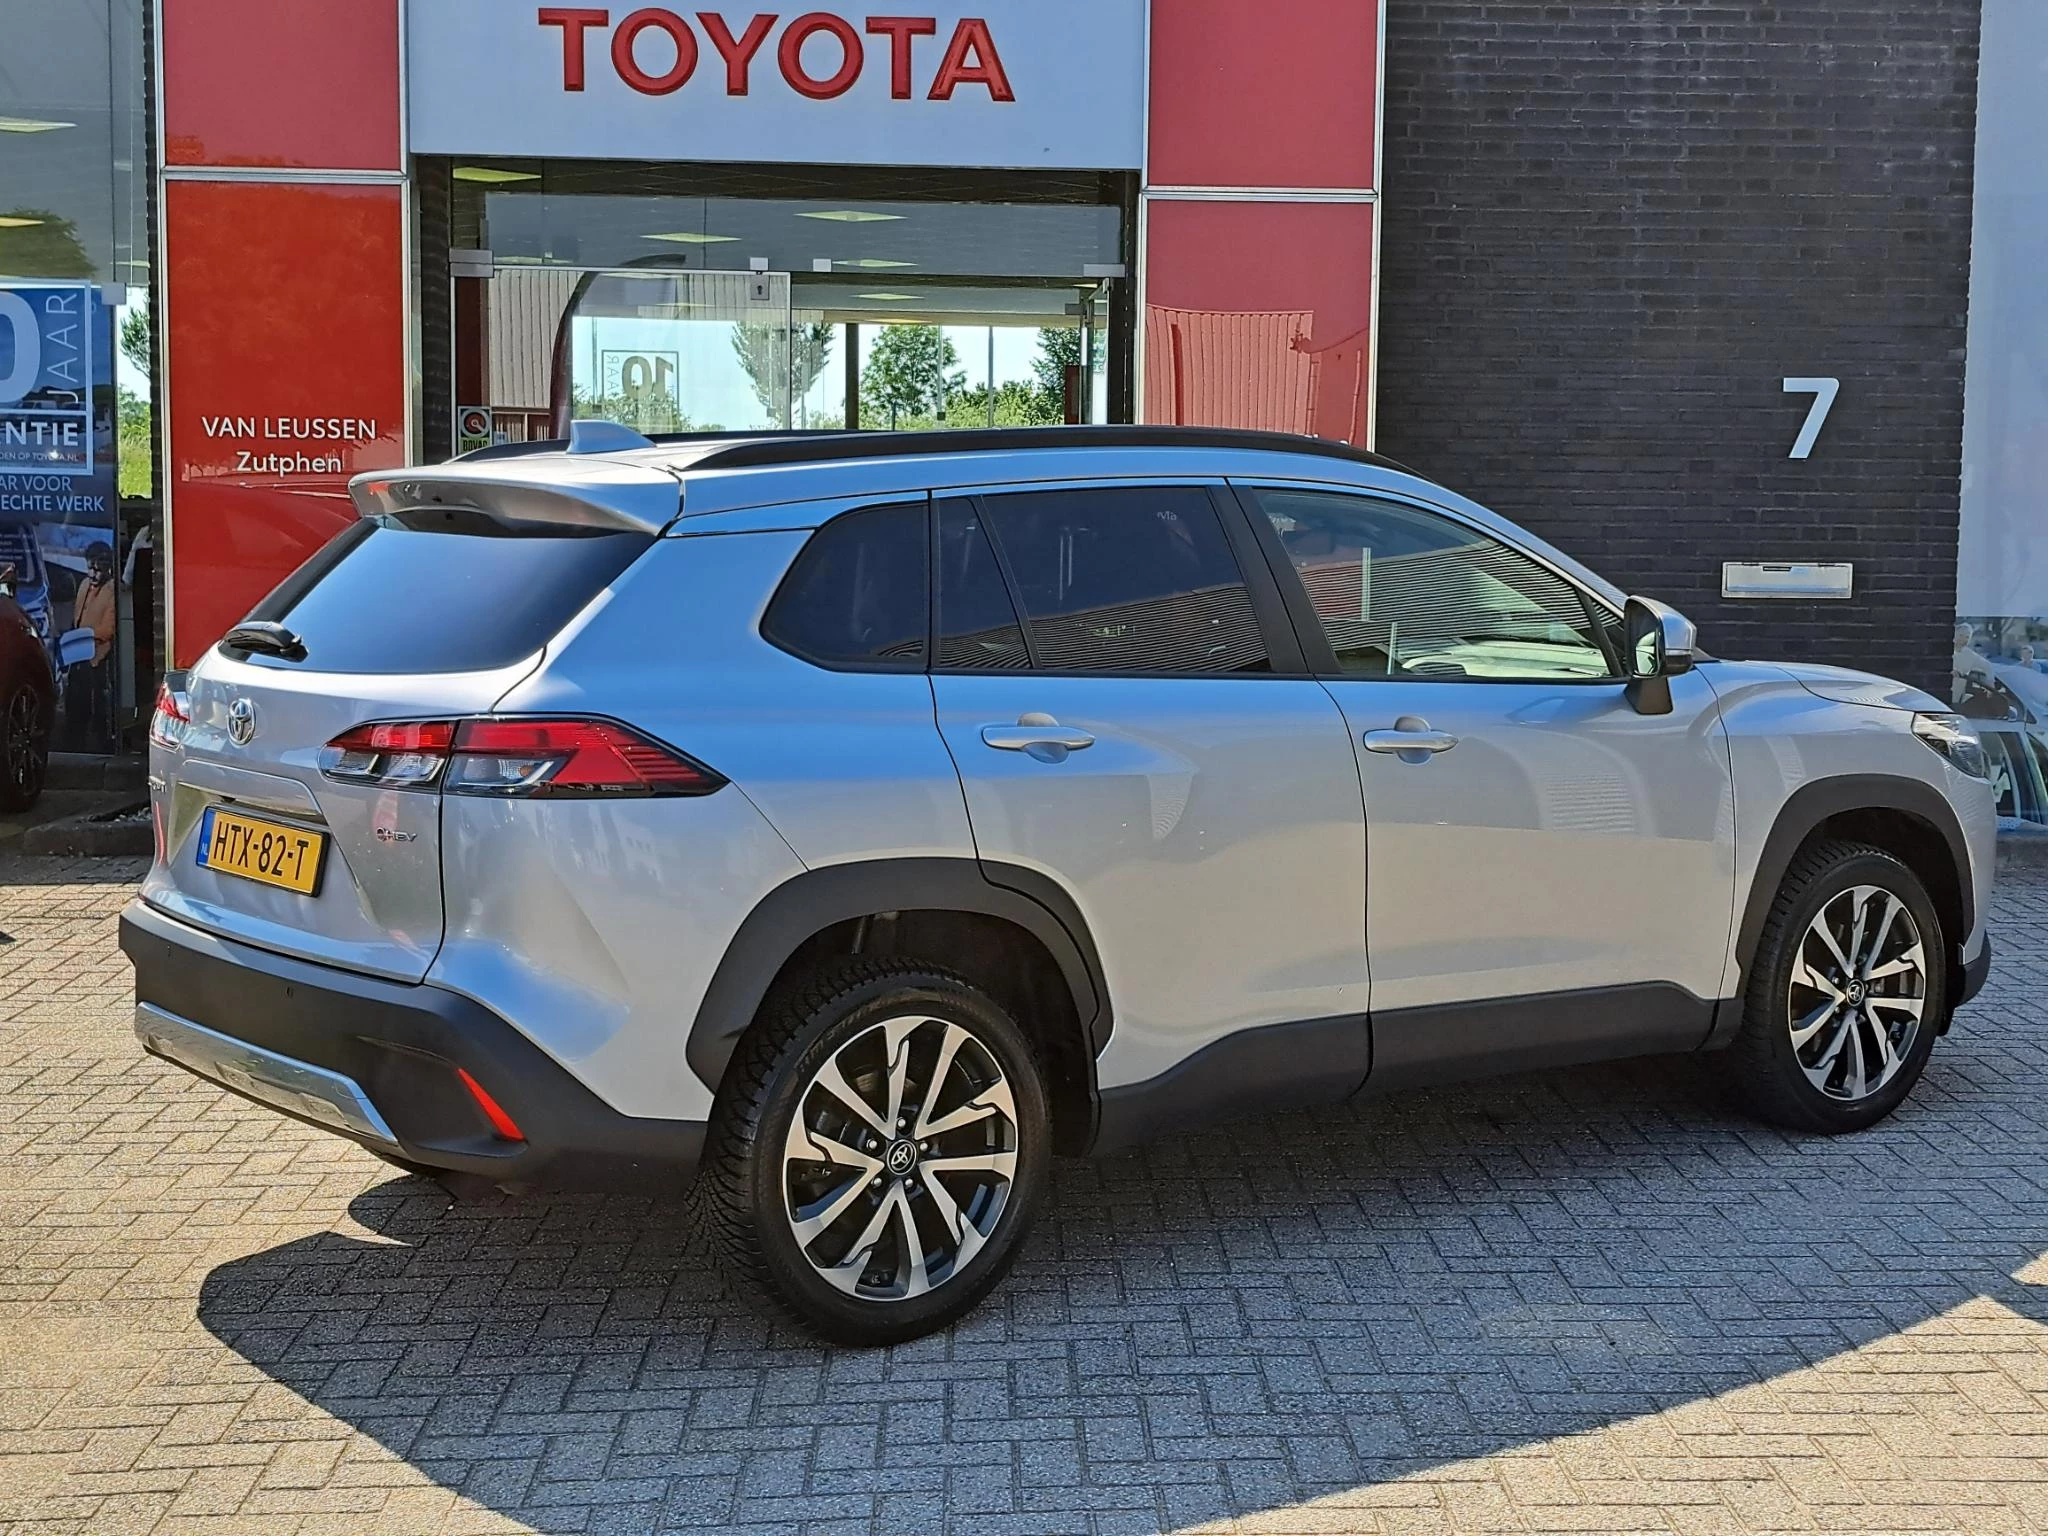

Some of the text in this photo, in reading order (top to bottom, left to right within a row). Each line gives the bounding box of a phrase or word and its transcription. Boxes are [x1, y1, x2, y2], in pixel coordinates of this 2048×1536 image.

[538, 7, 1016, 102] TOYOTA
[46, 293, 79, 404] JAAR
[202, 416, 376, 440] VAN LEUSSEN
[1783, 377, 1840, 459] 7
[22, 475, 73, 491] VOOR
[236, 450, 342, 477] Zutphen
[1, 494, 104, 512] ECHTE WERK
[213, 821, 310, 881] HTX-82-T
